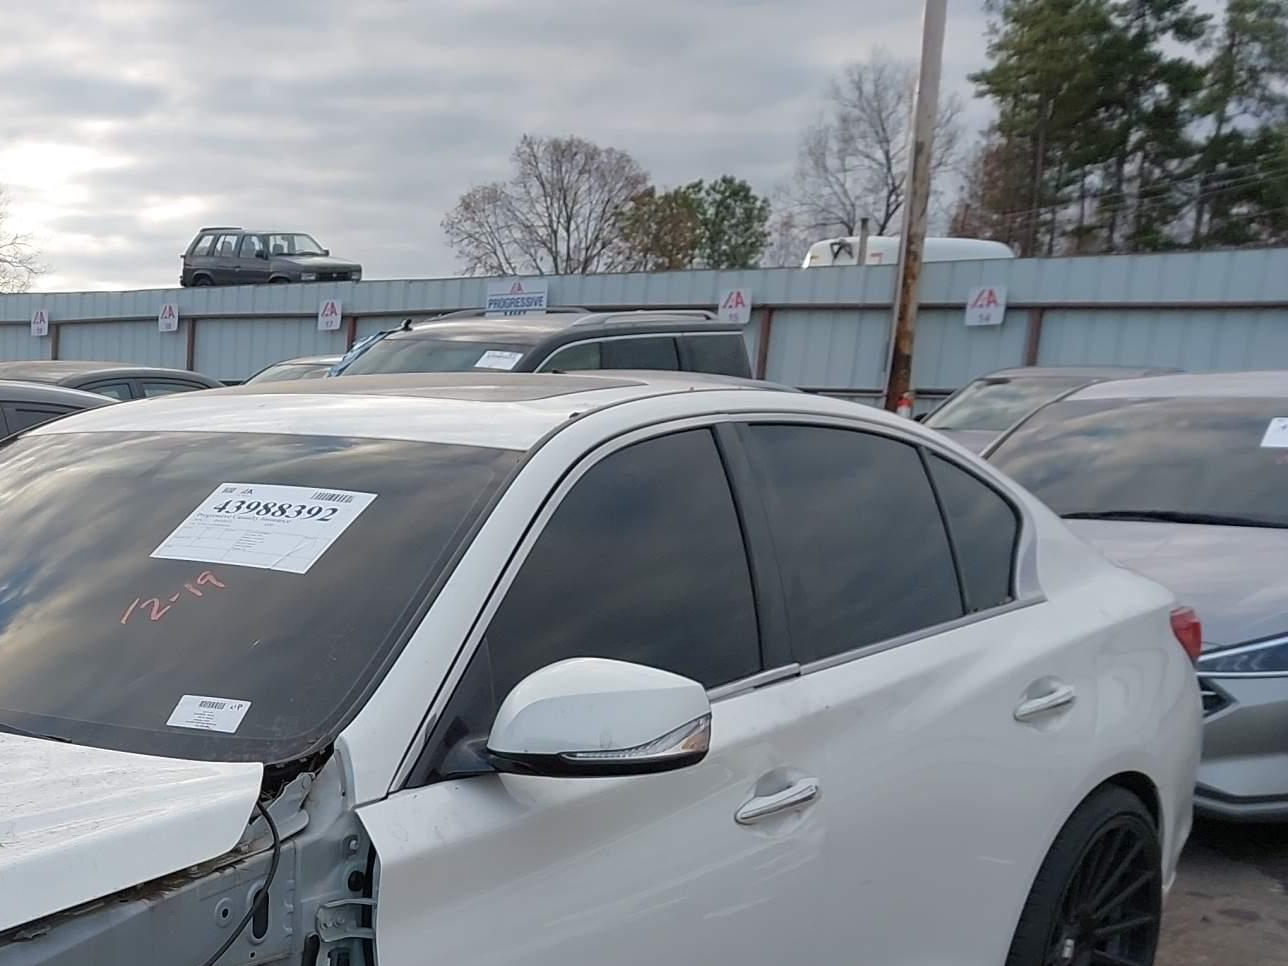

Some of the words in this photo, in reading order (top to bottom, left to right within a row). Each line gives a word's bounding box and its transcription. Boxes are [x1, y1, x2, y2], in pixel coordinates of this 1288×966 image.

[487, 295, 545, 309] PROGRESSIVE
[212, 499, 339, 522] 43988392
[120, 570, 225, 625] 12-19
